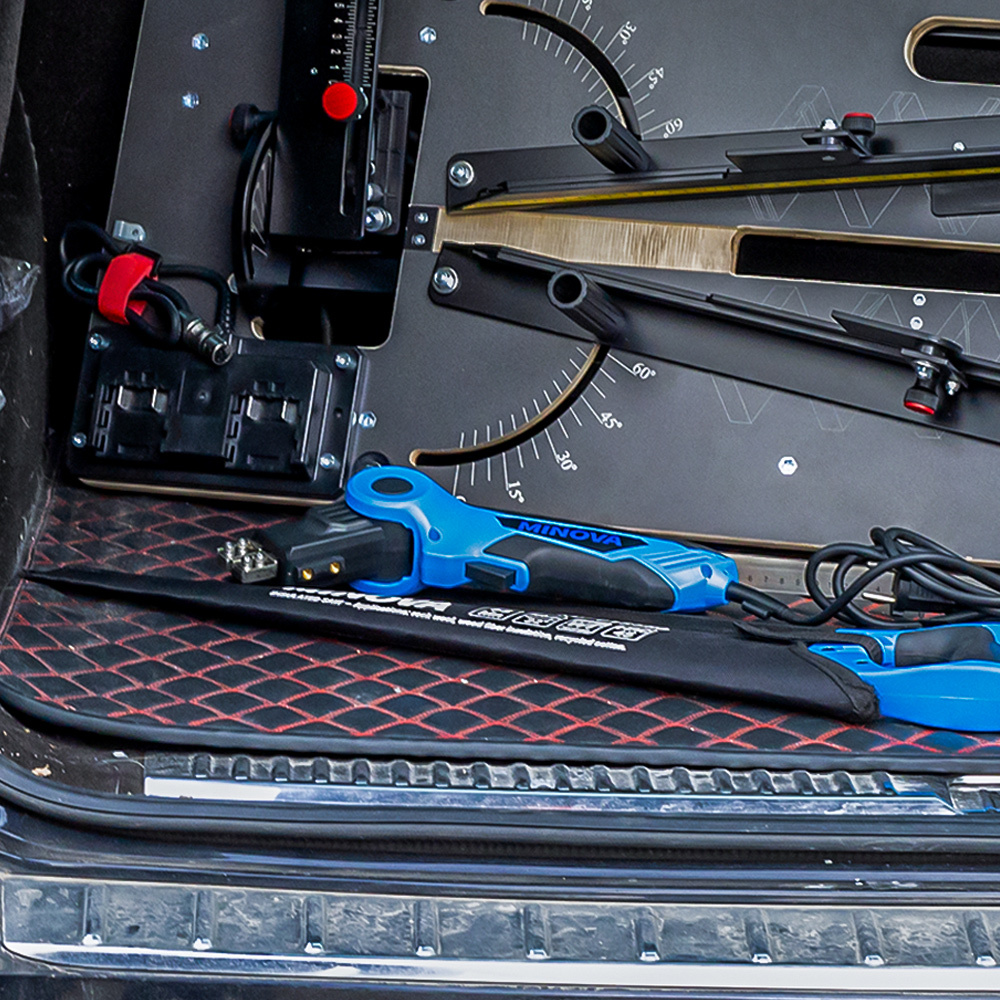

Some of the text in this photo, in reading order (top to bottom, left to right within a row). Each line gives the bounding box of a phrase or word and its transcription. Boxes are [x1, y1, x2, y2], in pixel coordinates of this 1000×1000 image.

[508, 362, 656, 503] 60° 45° 30° 15°
[518, 522, 623, 547] MINOVA
